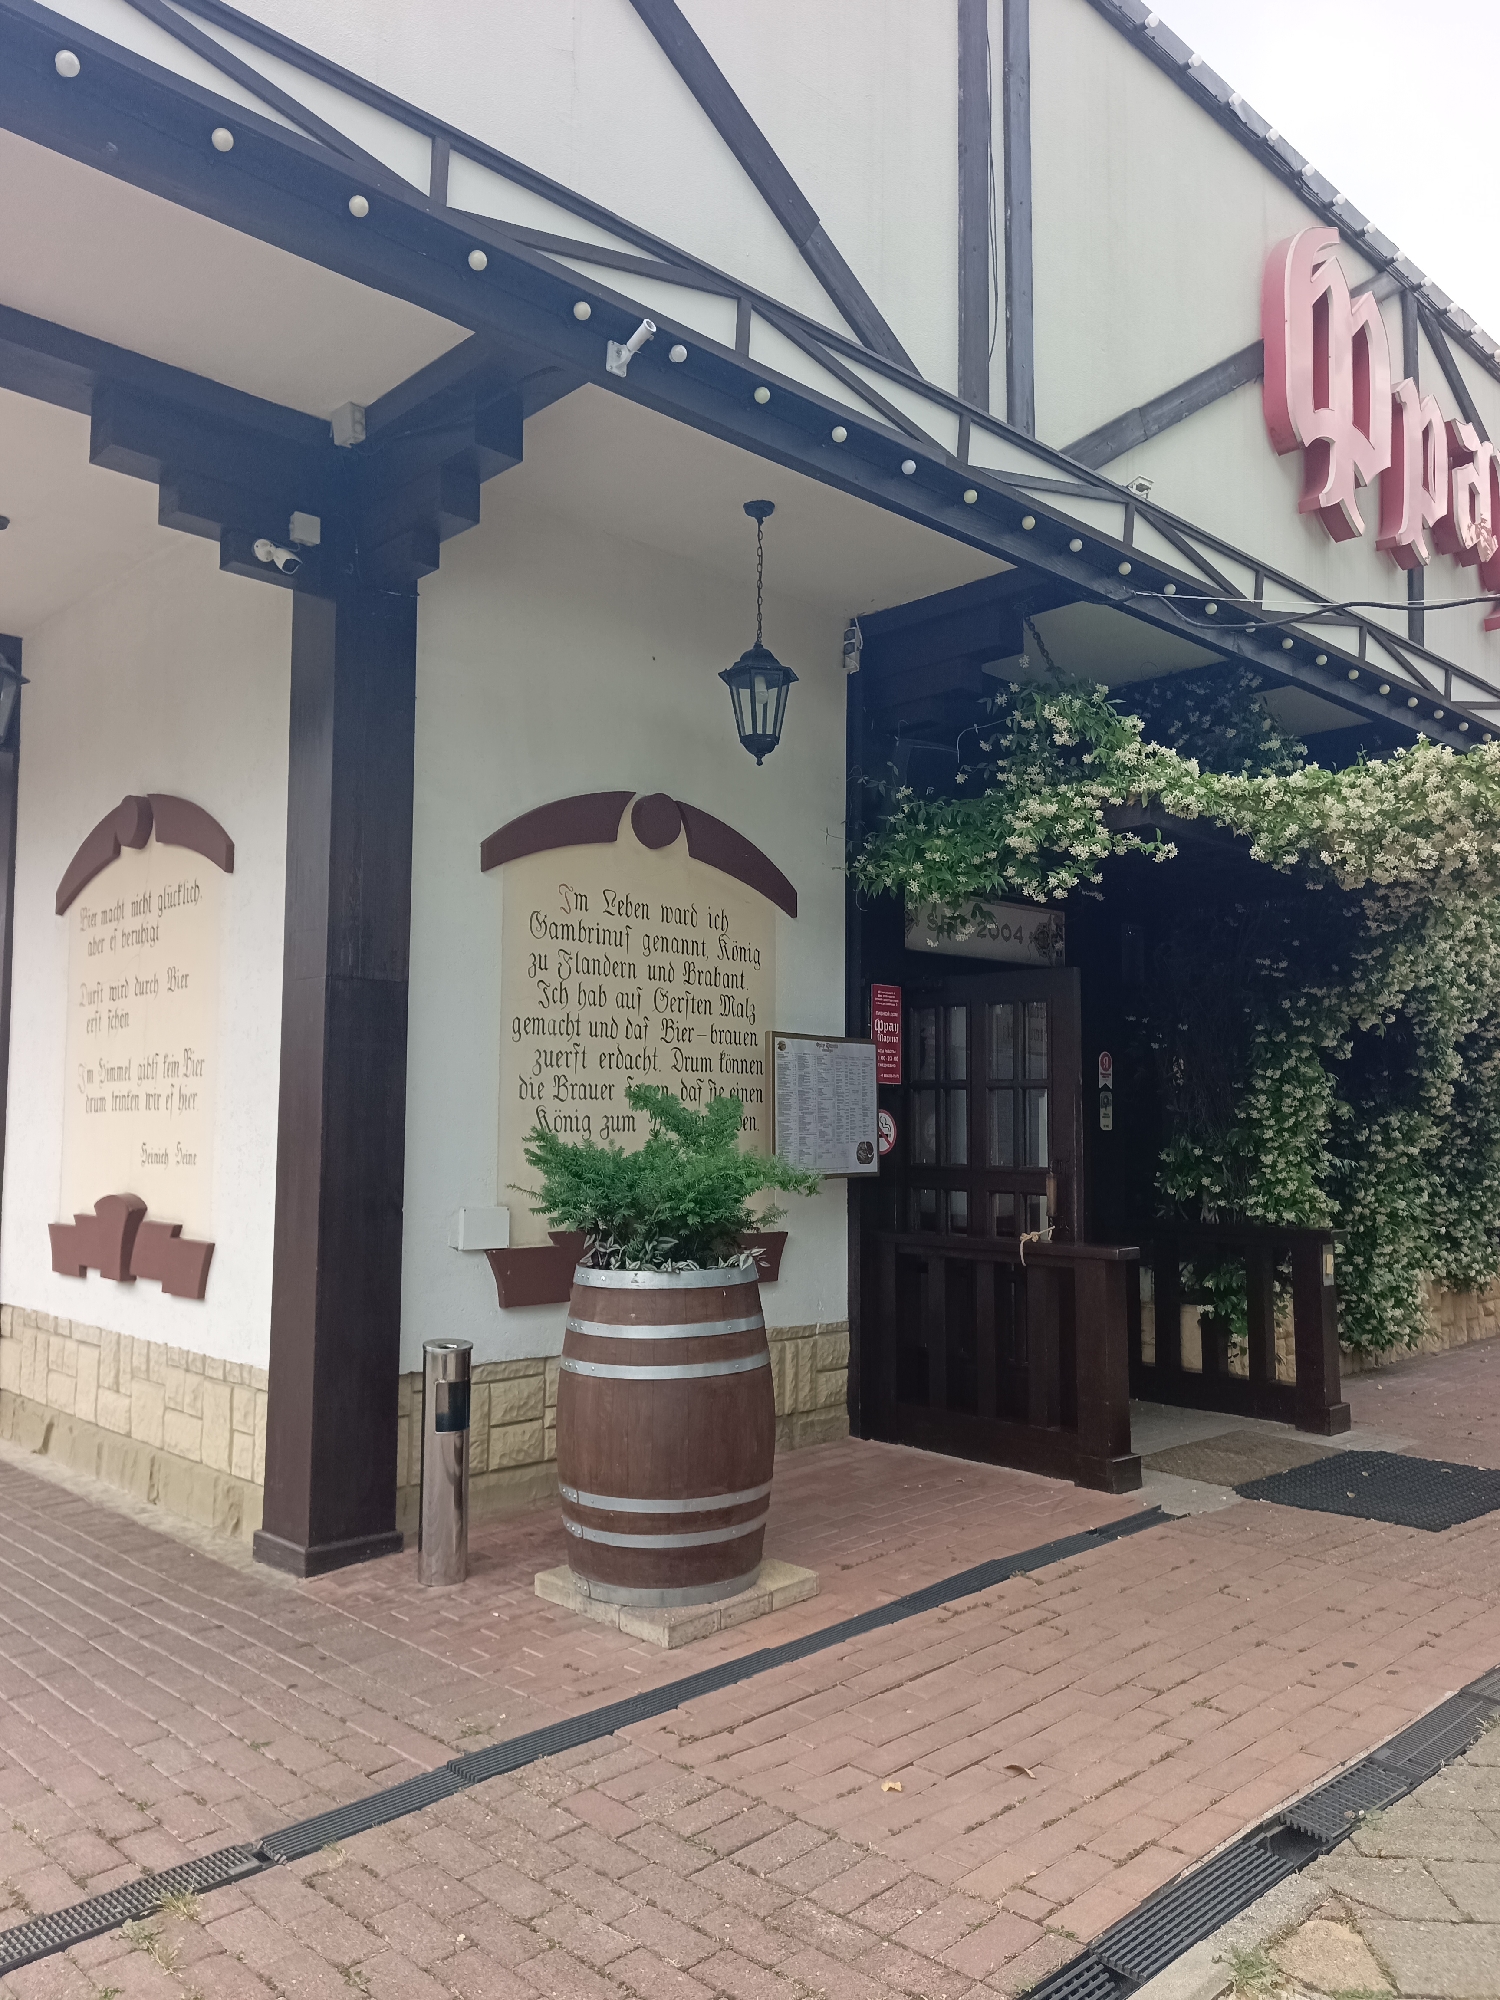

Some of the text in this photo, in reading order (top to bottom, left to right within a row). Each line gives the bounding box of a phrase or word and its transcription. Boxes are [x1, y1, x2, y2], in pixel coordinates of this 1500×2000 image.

[1263, 226, 1500, 632] Фра
[80, 906, 97, 931] Bier
[101, 897, 124, 926] macht
[131, 890, 152, 918] nicht
[559, 883, 729, 934] Im Leben ward ich
[88, 934, 105, 957] aber
[976, 920, 1024, 944] 2004
[642, 933, 709, 961] genannt,
[717, 934, 761, 970] König
[109, 976, 129, 1002] wird
[134, 971, 159, 1000] durch
[167, 966, 189, 992] Bier
[528, 949, 749, 991] zu Flandern und Brabant.
[537, 979, 569, 1010] Ich
[577, 981, 607, 1011] hab
[718, 994, 756, 1025] Malz
[512, 1013, 581, 1042] gemacht
[589, 1016, 618, 1040] und
[874, 1018, 899, 1034] Фрау
[77, 1062, 93, 1094] Im
[98, 1057, 131, 1089] Himmel
[182, 1048, 205, 1078] Bier
[599, 1043, 662, 1075] erdacht.
[671, 1047, 714, 1074] Drum
[719, 1050, 765, 1076] können
[86, 1093, 106, 1113] drum
[145, 1087, 161, 1111] wir
[518, 1075, 545, 1101] die
[552, 1074, 615, 1102] Brauer
[730, 1082, 763, 1104] einen
[535, 1104, 592, 1140] König
[599, 1113, 637, 1140] zum
